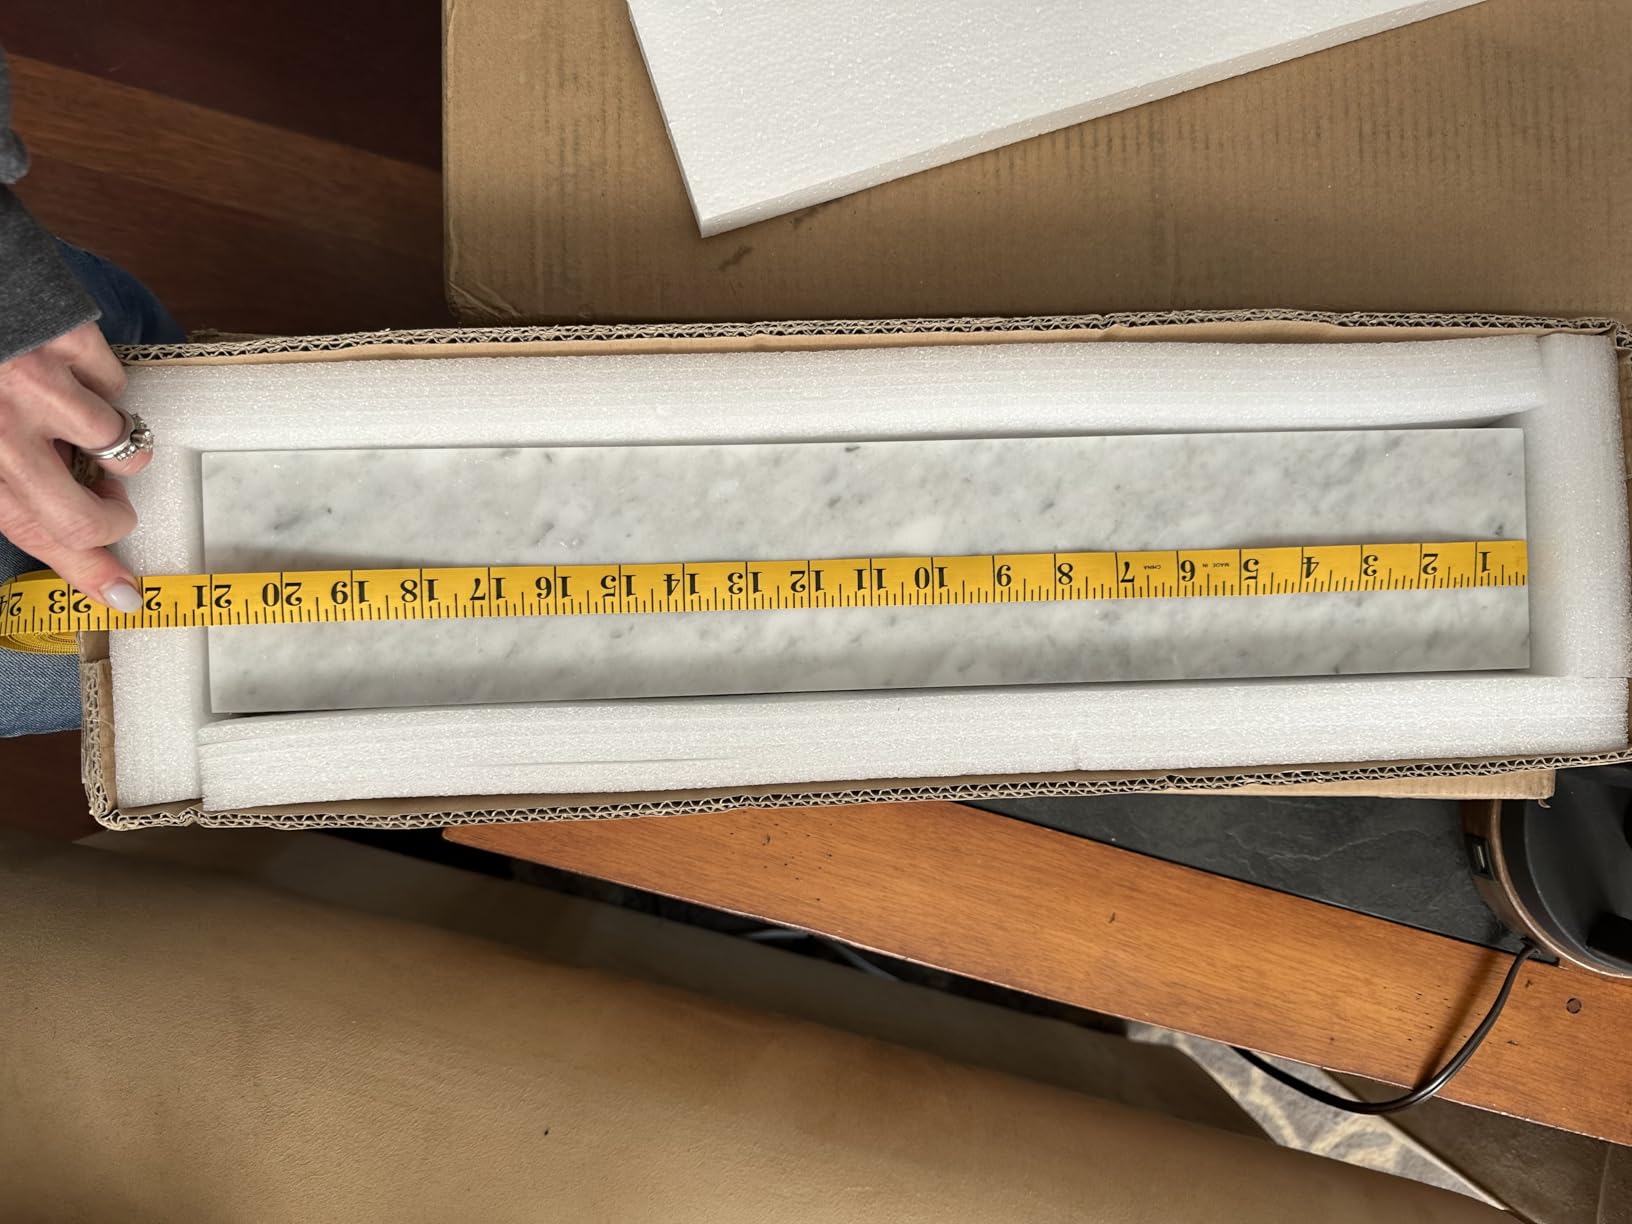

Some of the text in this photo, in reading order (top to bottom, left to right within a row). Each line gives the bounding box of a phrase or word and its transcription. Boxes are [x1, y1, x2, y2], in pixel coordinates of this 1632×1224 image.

[1057, 562, 1073, 585] 8
[1120, 561, 1135, 584] 7
[1180, 560, 1196, 582] 6
[1243, 558, 1260, 581] 5
[1302, 556, 1320, 579] 4
[1363, 554, 1379, 577] 3
[1422, 553, 1439, 575] 2
[1479, 551, 1492, 573] 1
[600, 574, 637, 598] 15
[663, 572, 700, 596] 14
[727, 571, 763, 595] 13
[790, 569, 825, 593] 12
[853, 568, 886, 591] 11
[914, 566, 949, 589] 10
[996, 564, 1012, 587] 9
[145, 587, 162, 611] 2
[192, 584, 232, 609] 21
[262, 582, 303, 607] 20
[331, 580, 370, 605] 19
[400, 578, 439, 603] 18
[470, 577, 506, 601] 17
[535, 576, 572, 600] 16
[48, 589, 92, 614] 23
